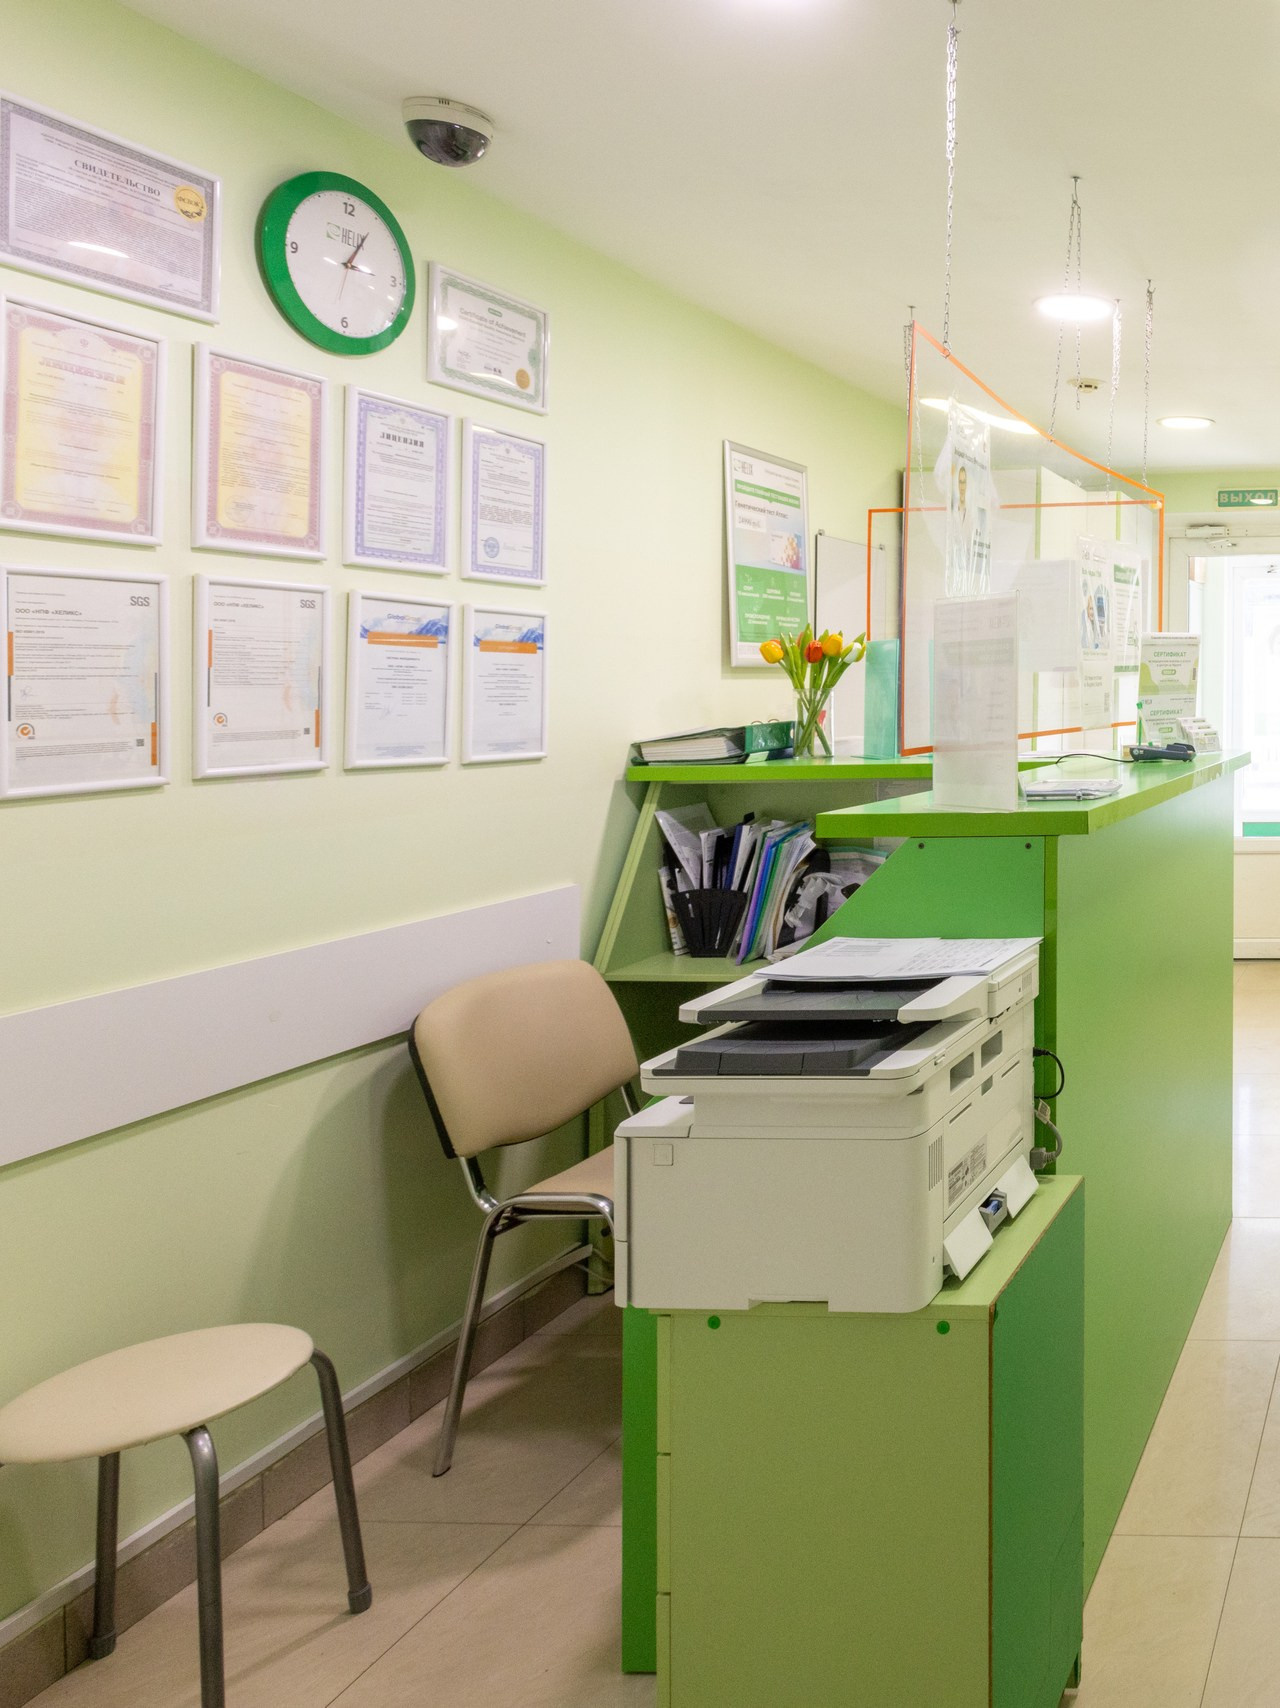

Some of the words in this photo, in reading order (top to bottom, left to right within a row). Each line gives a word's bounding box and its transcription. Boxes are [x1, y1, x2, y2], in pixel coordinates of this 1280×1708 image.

[74, 158, 161, 198] СВИДЕТЕЛЬСТВО
[342, 202, 355, 217] 12
[290, 241, 299, 254] 9
[390, 275, 398, 288] 3
[340, 316, 349, 328] 6
[1219, 490, 1276, 507] ВЫХОД
[130, 596, 150, 607] SGS
[299, 599, 316, 609] SGS
